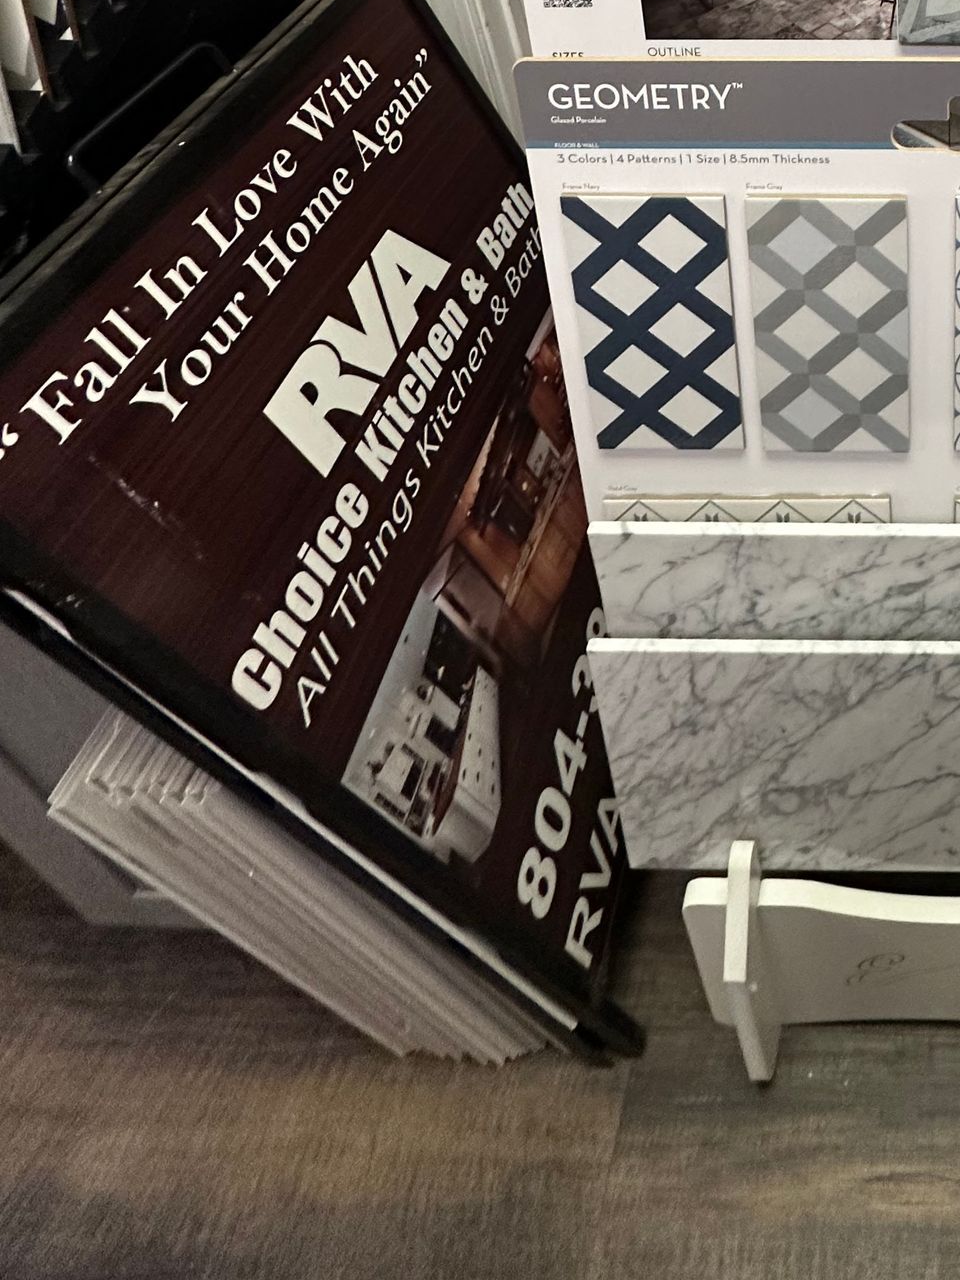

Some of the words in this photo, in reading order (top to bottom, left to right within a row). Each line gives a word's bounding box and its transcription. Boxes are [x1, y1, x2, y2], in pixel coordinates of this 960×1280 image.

[551, 116, 575, 124] Glazed
[576, 116, 607, 124] Porcelain
[557, 154, 565, 163] 3
[568, 154, 607, 163] Colors
[617, 154, 624, 163] 4
[628, 154, 677, 163] Patterns
[686, 154, 692, 163] 1
[696, 154, 720, 163] Size
[729, 154, 769, 163] 8.5mm
[772, 154, 830, 163] Thickness
[647, 46, 702, 57] OUTLINE
[129, 291, 253, 422] Your
[242, 166, 354, 296] Home
[134, 255, 208, 320] In
[191, 149, 298, 257] Love
[286, 54, 379, 144] With
[231, 482, 369, 711] Choice
[355, 297, 468, 483] Kitchen
[461, 267, 489, 305] &
[476, 182, 534, 270] Bath
[263, 229, 451, 478] RVA
[296, 633, 339, 728] All
[331, 474, 421, 630] Things
[416, 333, 494, 470] Kitchen
[490, 294, 509, 328] &
